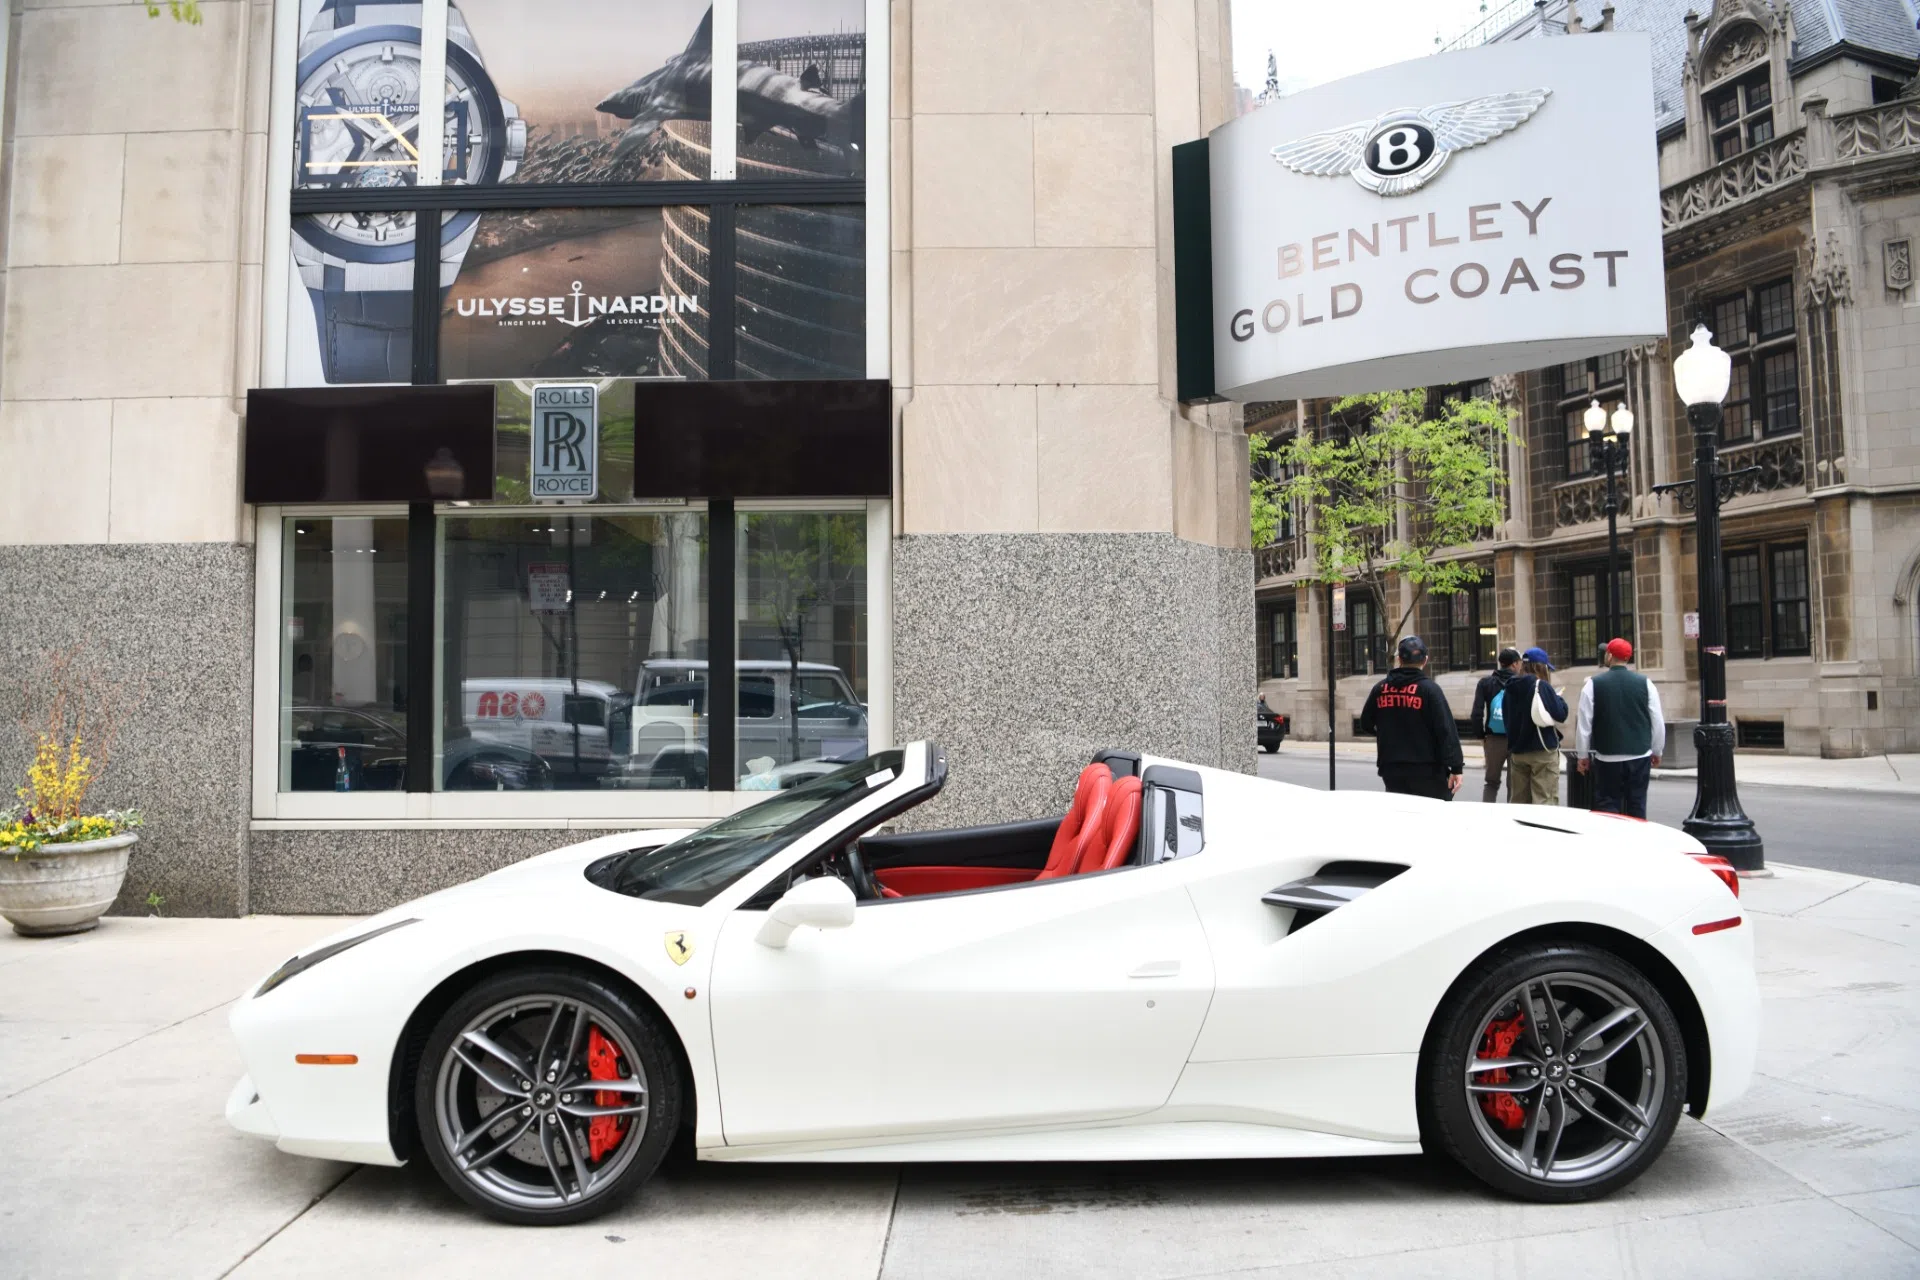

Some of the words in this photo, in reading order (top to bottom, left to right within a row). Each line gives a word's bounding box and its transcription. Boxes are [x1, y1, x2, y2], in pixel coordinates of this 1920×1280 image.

[390, 105, 419, 113] NARDI
[1376, 127, 1421, 171] B
[1277, 198, 1552, 280] BENTLEY
[457, 297, 565, 316] ULYSSE
[588, 295, 698, 314] NARDIN
[1230, 282, 1363, 342] GOLD
[1404, 250, 1628, 304] COAST
[539, 391, 590, 405] ROLLS
[542, 412, 587, 471] RR
[537, 479, 589, 492] ROYCE
